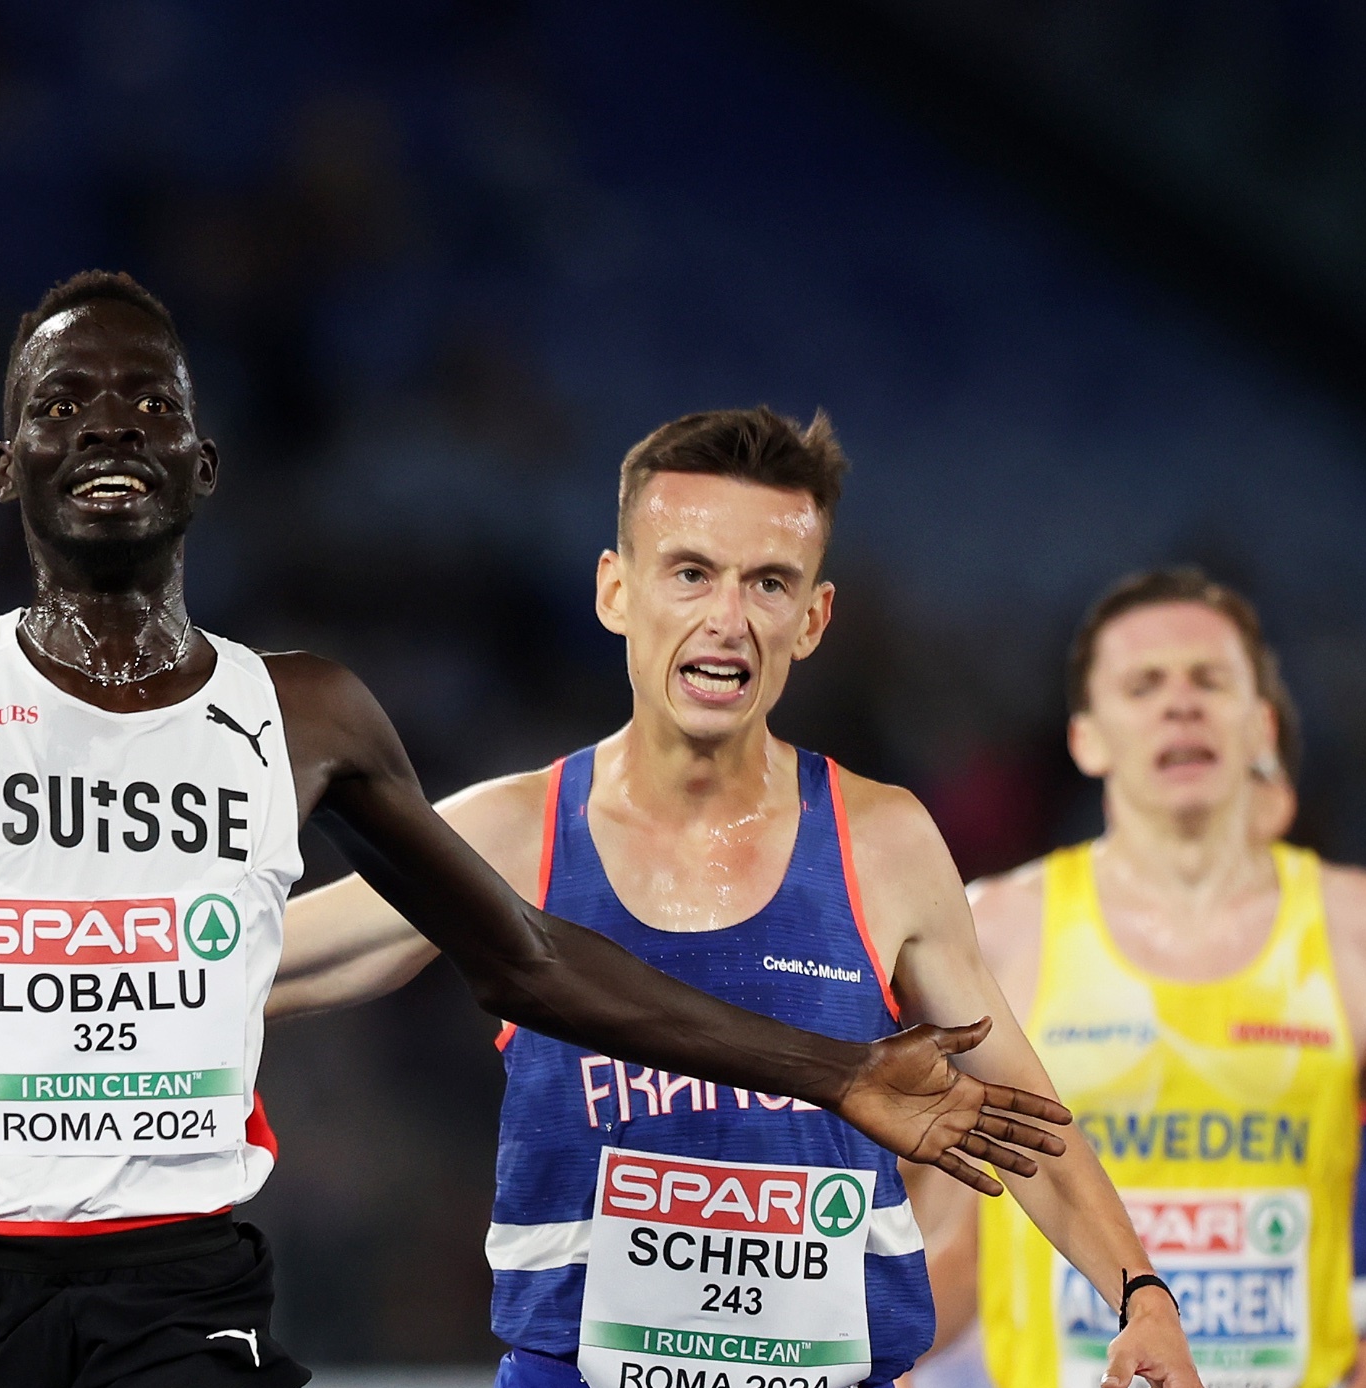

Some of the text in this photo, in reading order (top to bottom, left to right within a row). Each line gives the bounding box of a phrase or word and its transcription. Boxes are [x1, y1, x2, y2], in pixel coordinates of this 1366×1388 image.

[762, 955, 862, 984] Crédit Mutuel
[73, 1022, 138, 1053] 325
[21, 1076, 29, 1099] I
[35, 1075, 96, 1099] RUN
[2, 1108, 218, 1143] ROMA 2024
[608, 1163, 803, 1226] SPAR
[627, 1226, 829, 1281] SCHRUB
[700, 1283, 764, 1316] 243
[1062, 1269, 1296, 1337] ALGREN
[643, 1329, 651, 1350] I
[656, 1330, 716, 1357] RUN
